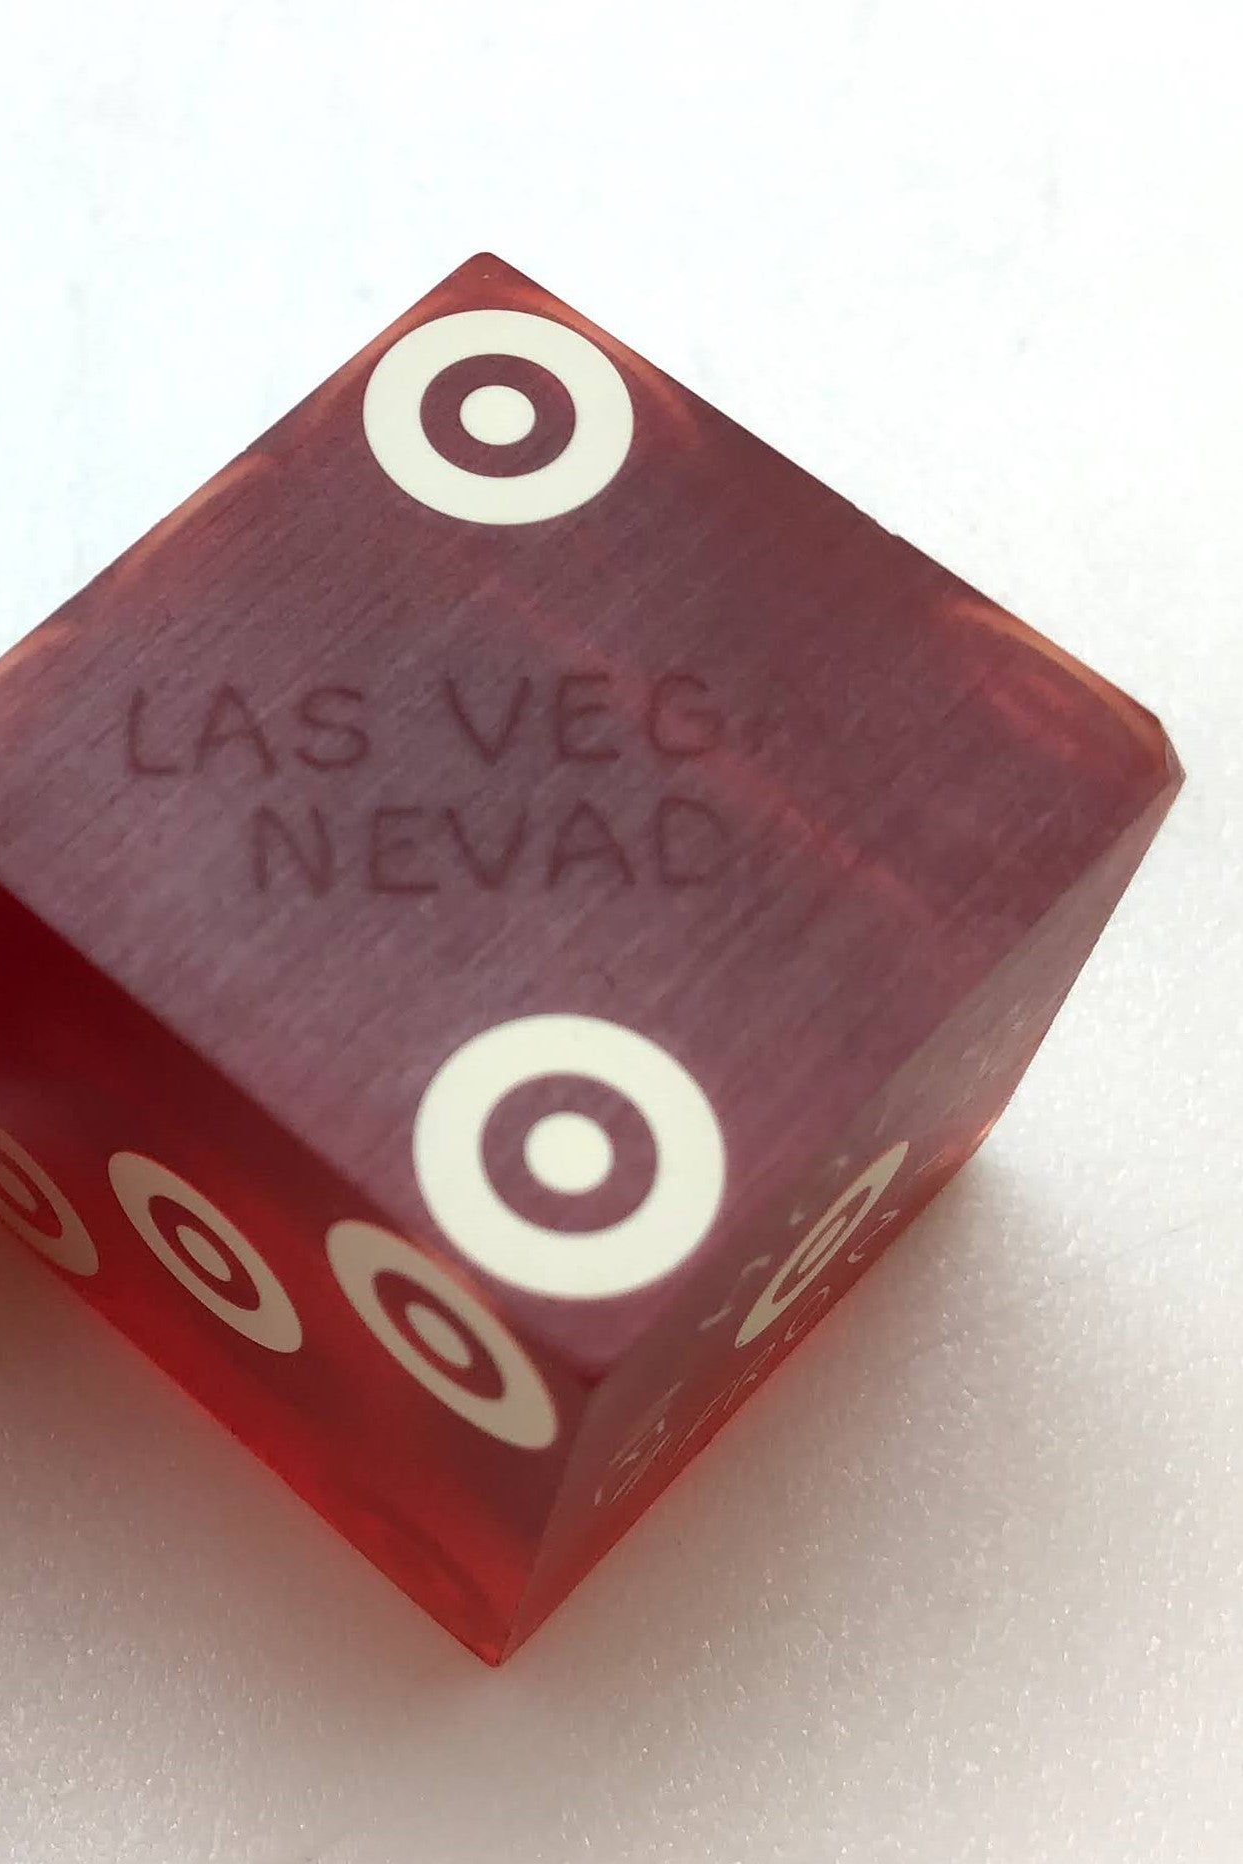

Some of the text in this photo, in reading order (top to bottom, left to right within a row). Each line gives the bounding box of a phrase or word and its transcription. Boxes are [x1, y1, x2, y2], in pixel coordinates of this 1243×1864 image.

[124, 672, 724, 777] LAS VEG
[250, 795, 733, 896] NEVAD
